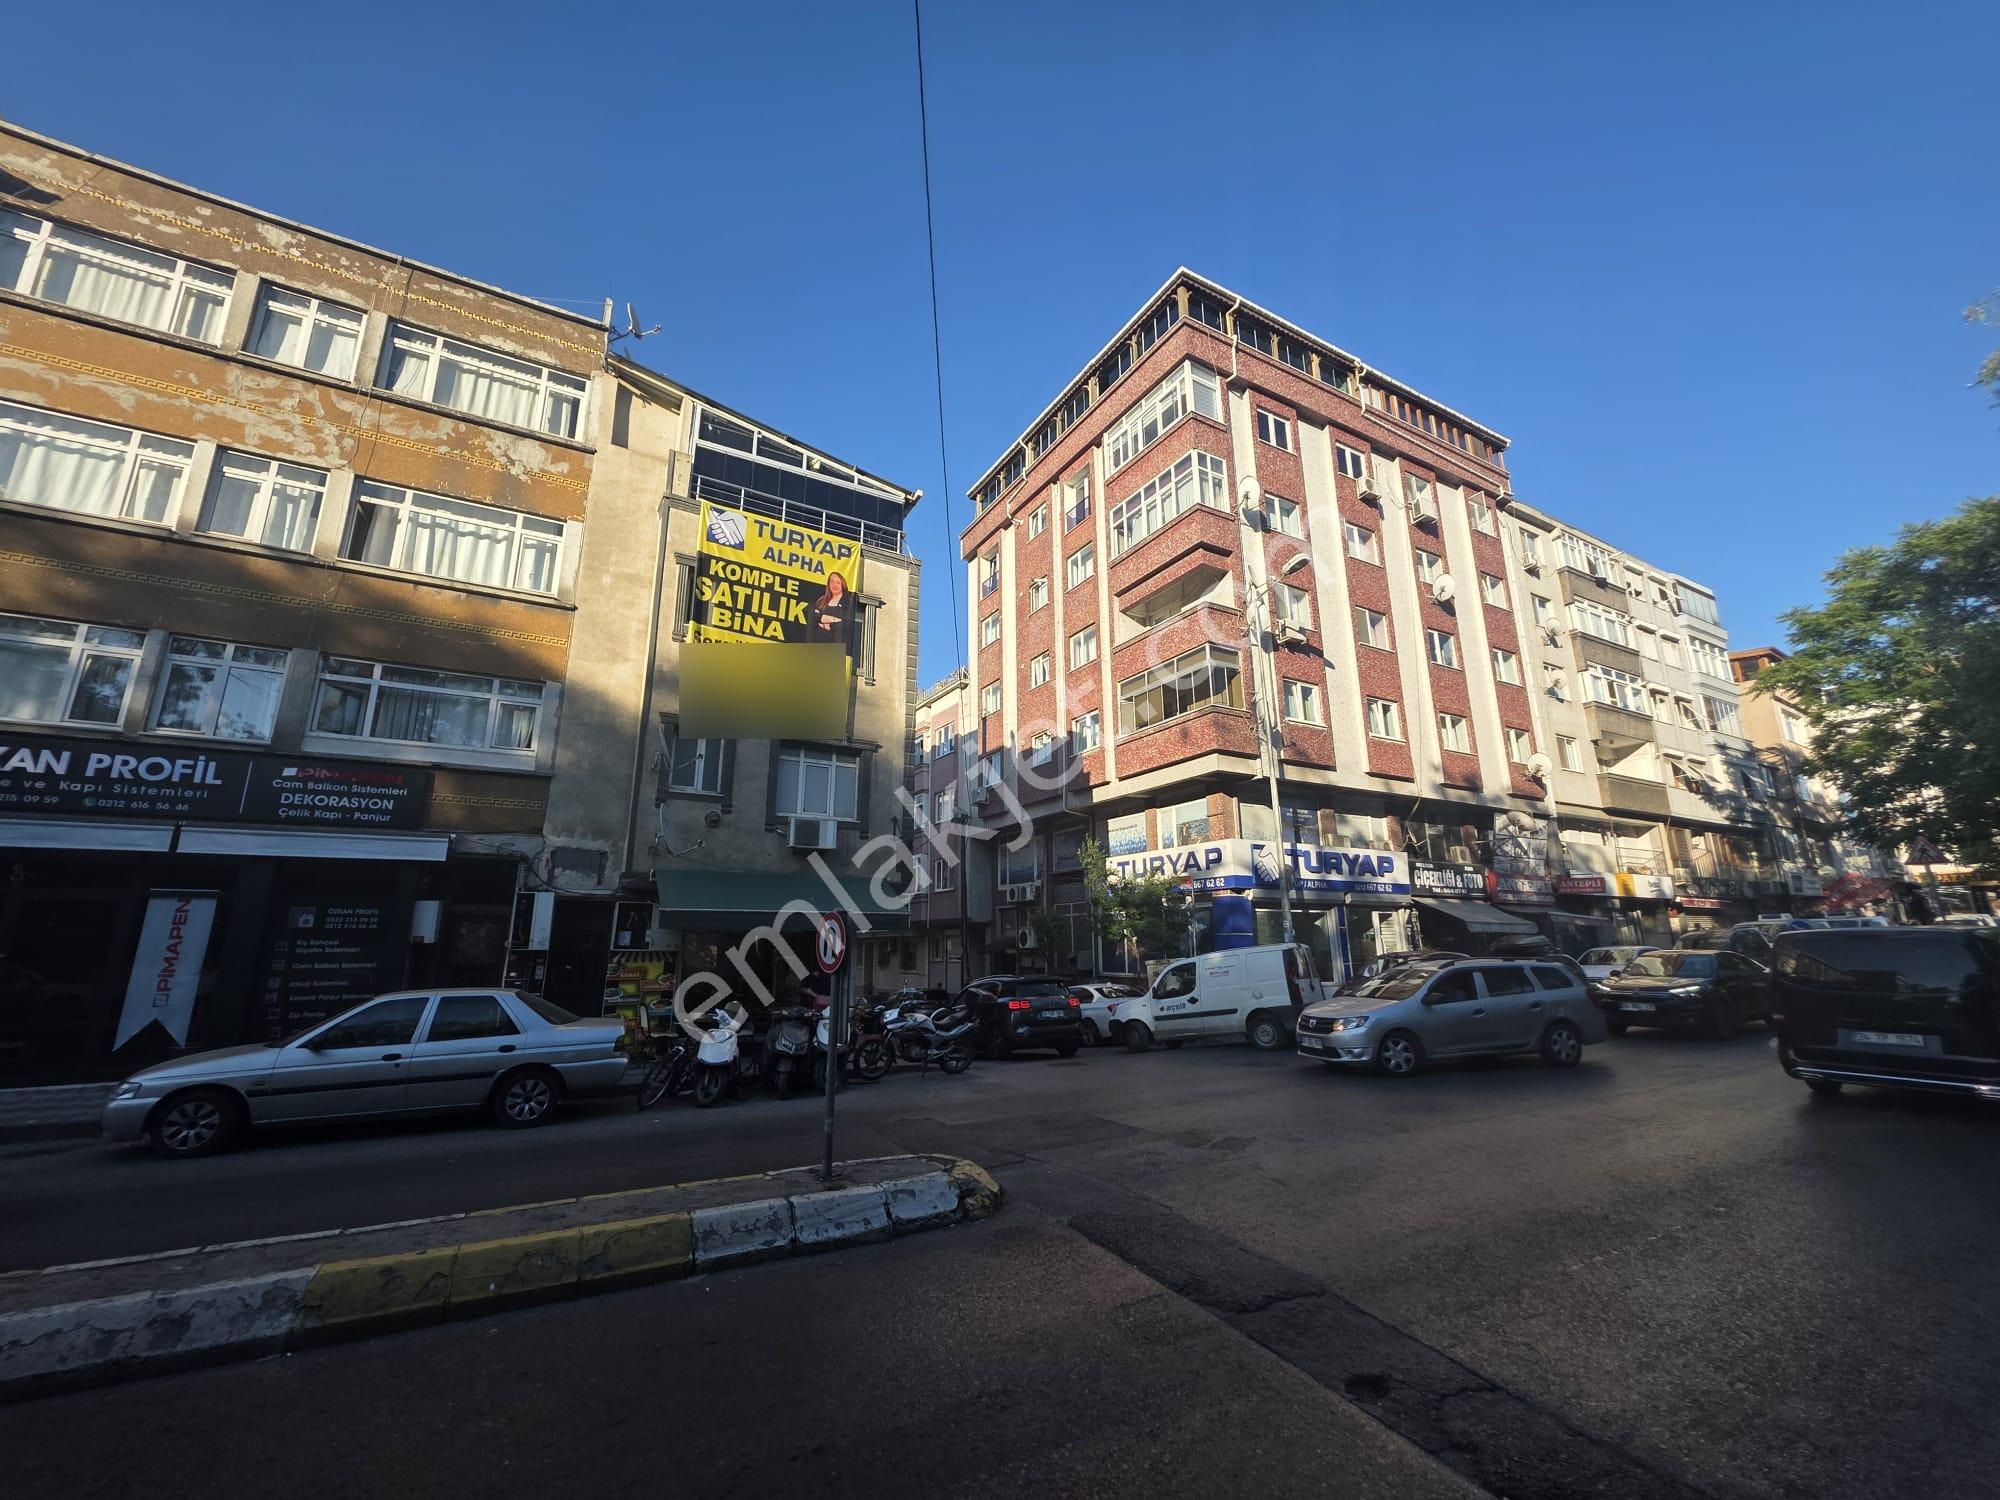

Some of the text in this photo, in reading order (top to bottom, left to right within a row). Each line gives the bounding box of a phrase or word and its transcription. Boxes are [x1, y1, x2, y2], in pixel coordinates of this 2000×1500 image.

[753, 519, 854, 561] TURYAP
[763, 546, 825, 576] ALPHA
[709, 559, 800, 597] KOMPLE
[696, 576, 810, 625] SATILIK
[84, 752, 223, 785] PROFİL
[23, 780, 47, 789] ve
[112, 784, 209, 799] Sistemleri
[272, 779, 408, 796] Cam Balkon Sistemleri
[23, 794, 40, 803] 09
[97, 799, 125, 808] 0212
[130, 801, 150, 810] 616
[155, 802, 171, 811] 56
[280, 792, 394, 810] DEKORASYON
[278, 807, 310, 819] Çelik
[314, 809, 342, 820] Kapı
[353, 812, 392, 823] Panjur
[1117, 847, 1223, 880] TURYAP
[1285, 849, 1395, 877] TURYAP
[1206, 878, 1216, 888] 62
[1216, 877, 1225, 887] 62
[1377, 884, 1385, 892] 62
[1385, 884, 1393, 892] 62
[1456, 875, 1463, 888] &
[1463, 873, 1484, 888] FOTO
